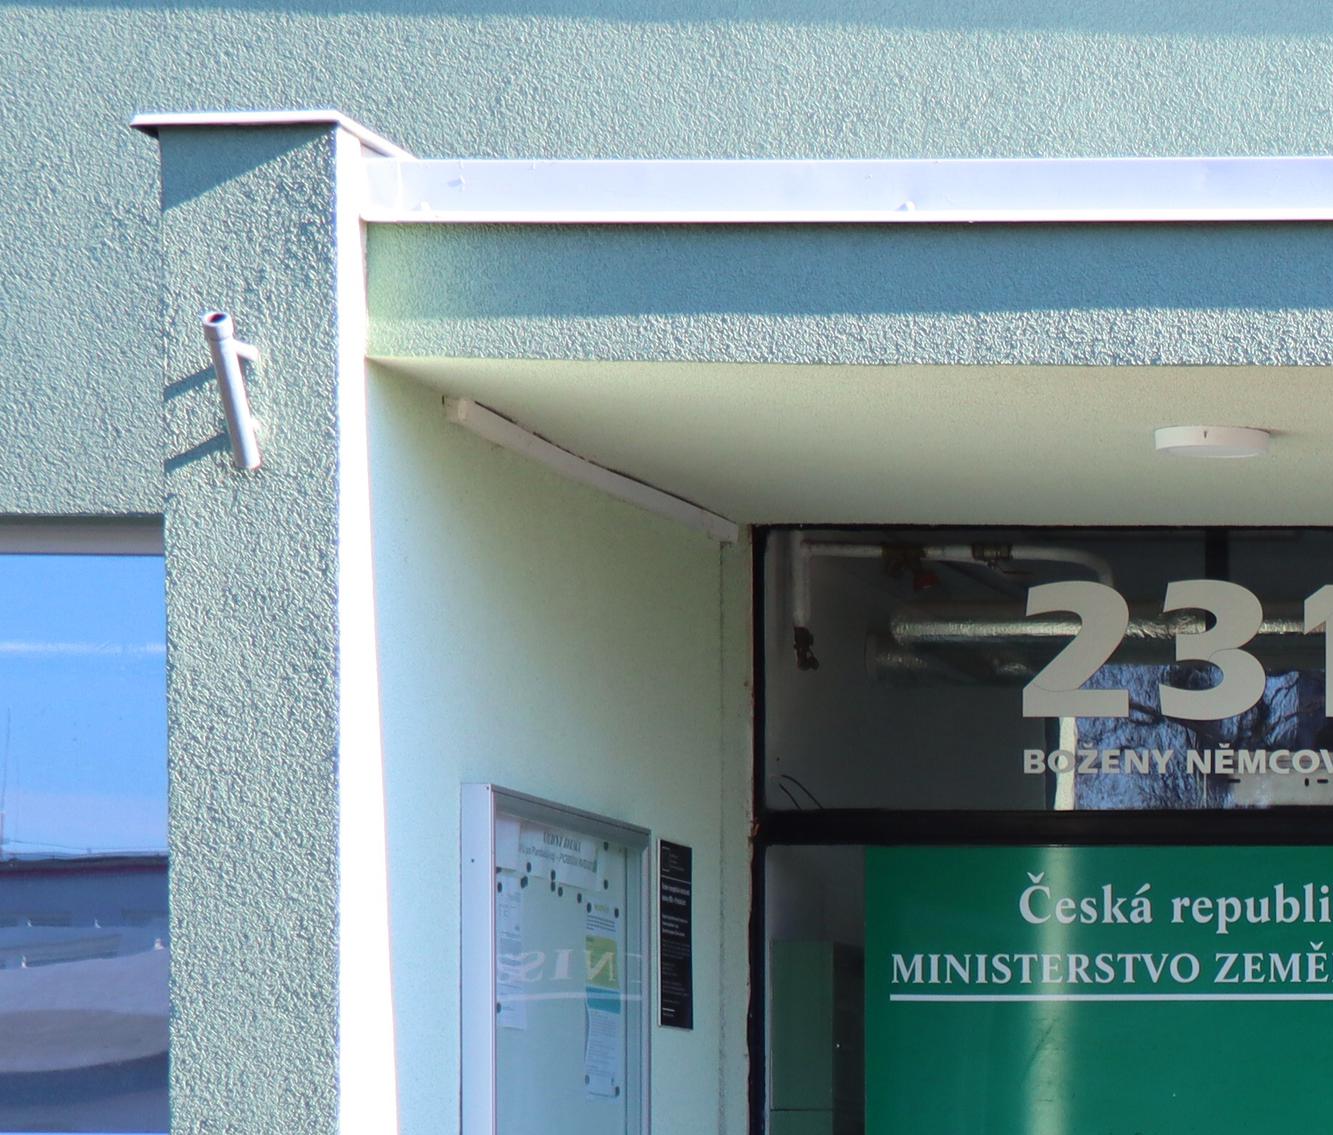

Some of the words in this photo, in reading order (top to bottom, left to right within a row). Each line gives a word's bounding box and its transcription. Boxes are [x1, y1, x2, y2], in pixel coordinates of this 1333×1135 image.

[1023, 742, 1175, 774] BOŽENY
[1019, 872, 1153, 924] Česká
[891, 952, 1200, 984] MINISTERSTVO
